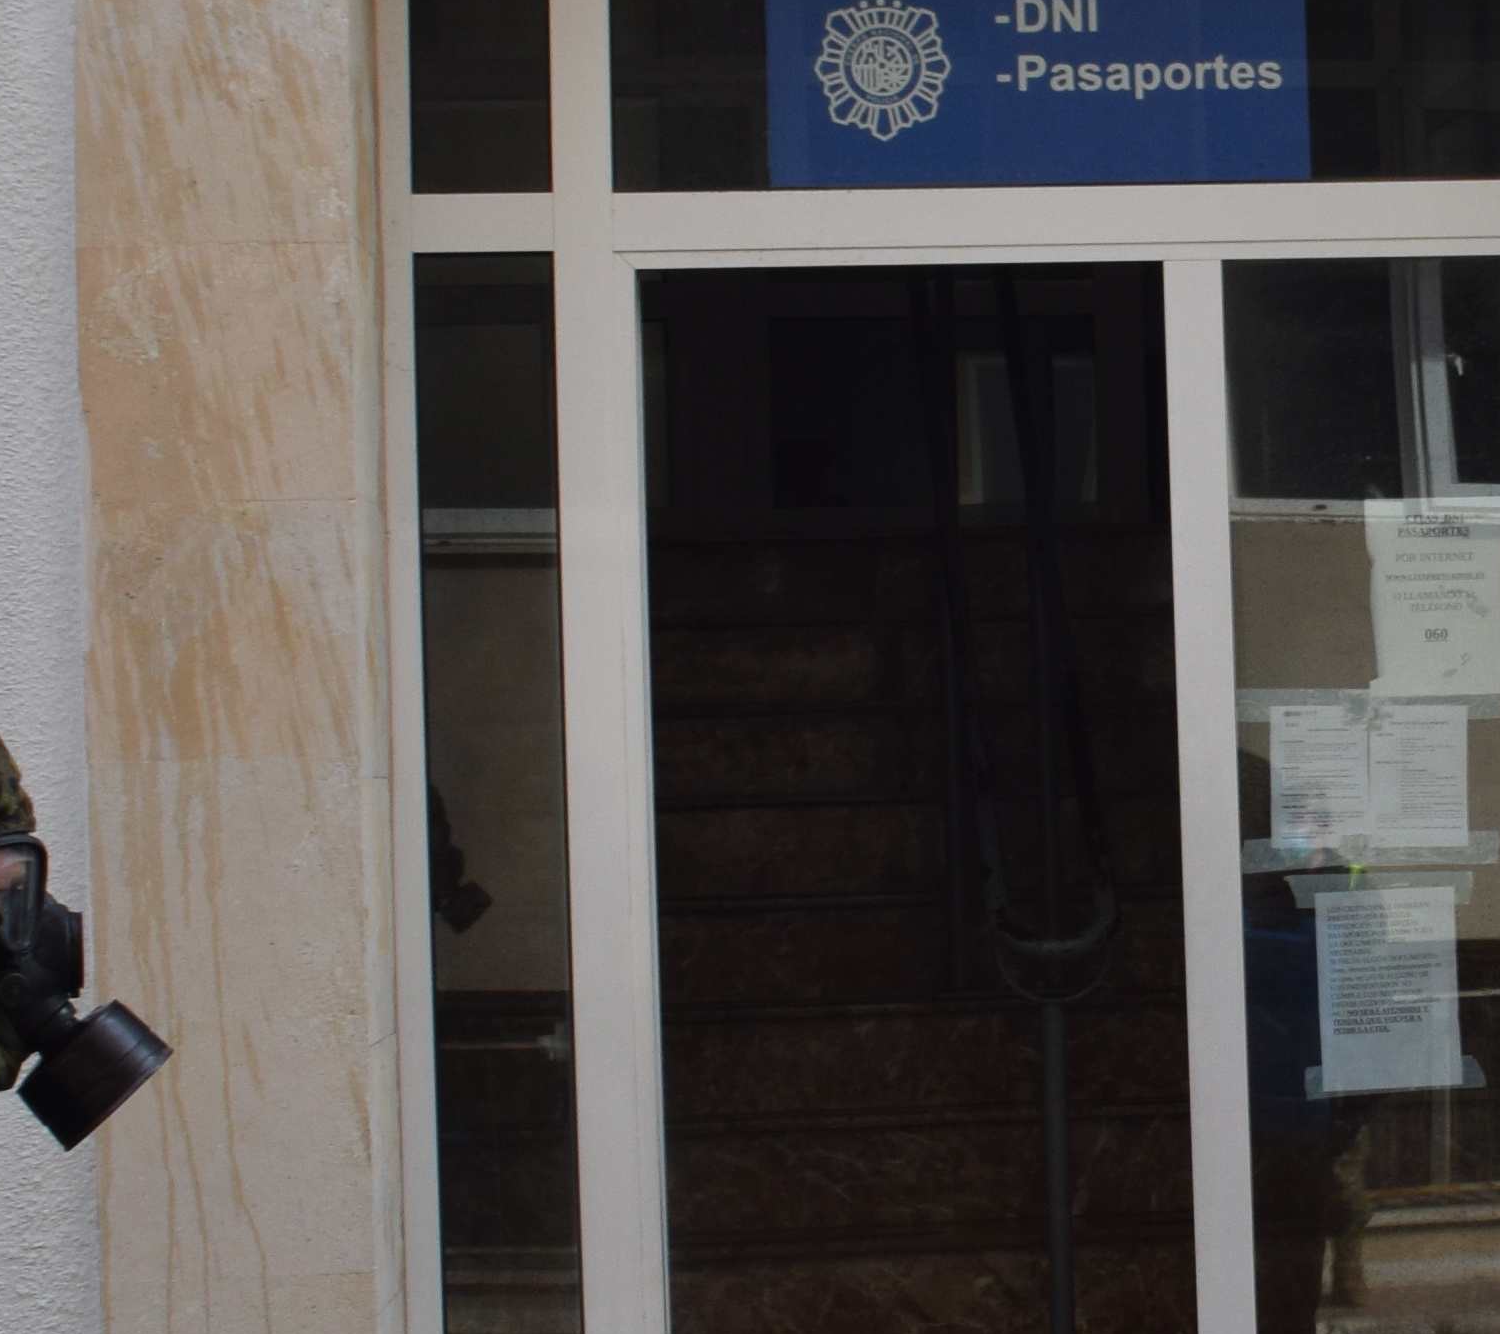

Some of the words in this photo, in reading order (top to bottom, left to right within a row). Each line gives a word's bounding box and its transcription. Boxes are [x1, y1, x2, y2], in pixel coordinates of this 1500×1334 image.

[996, 54, 1283, 100] -Pasaportes
[1398, 527, 1470, 537] PASAPORTES
[1396, 553, 1416, 562] POR
[1420, 552, 1473, 561] INTERNET
[1425, 629, 1448, 641] 060
